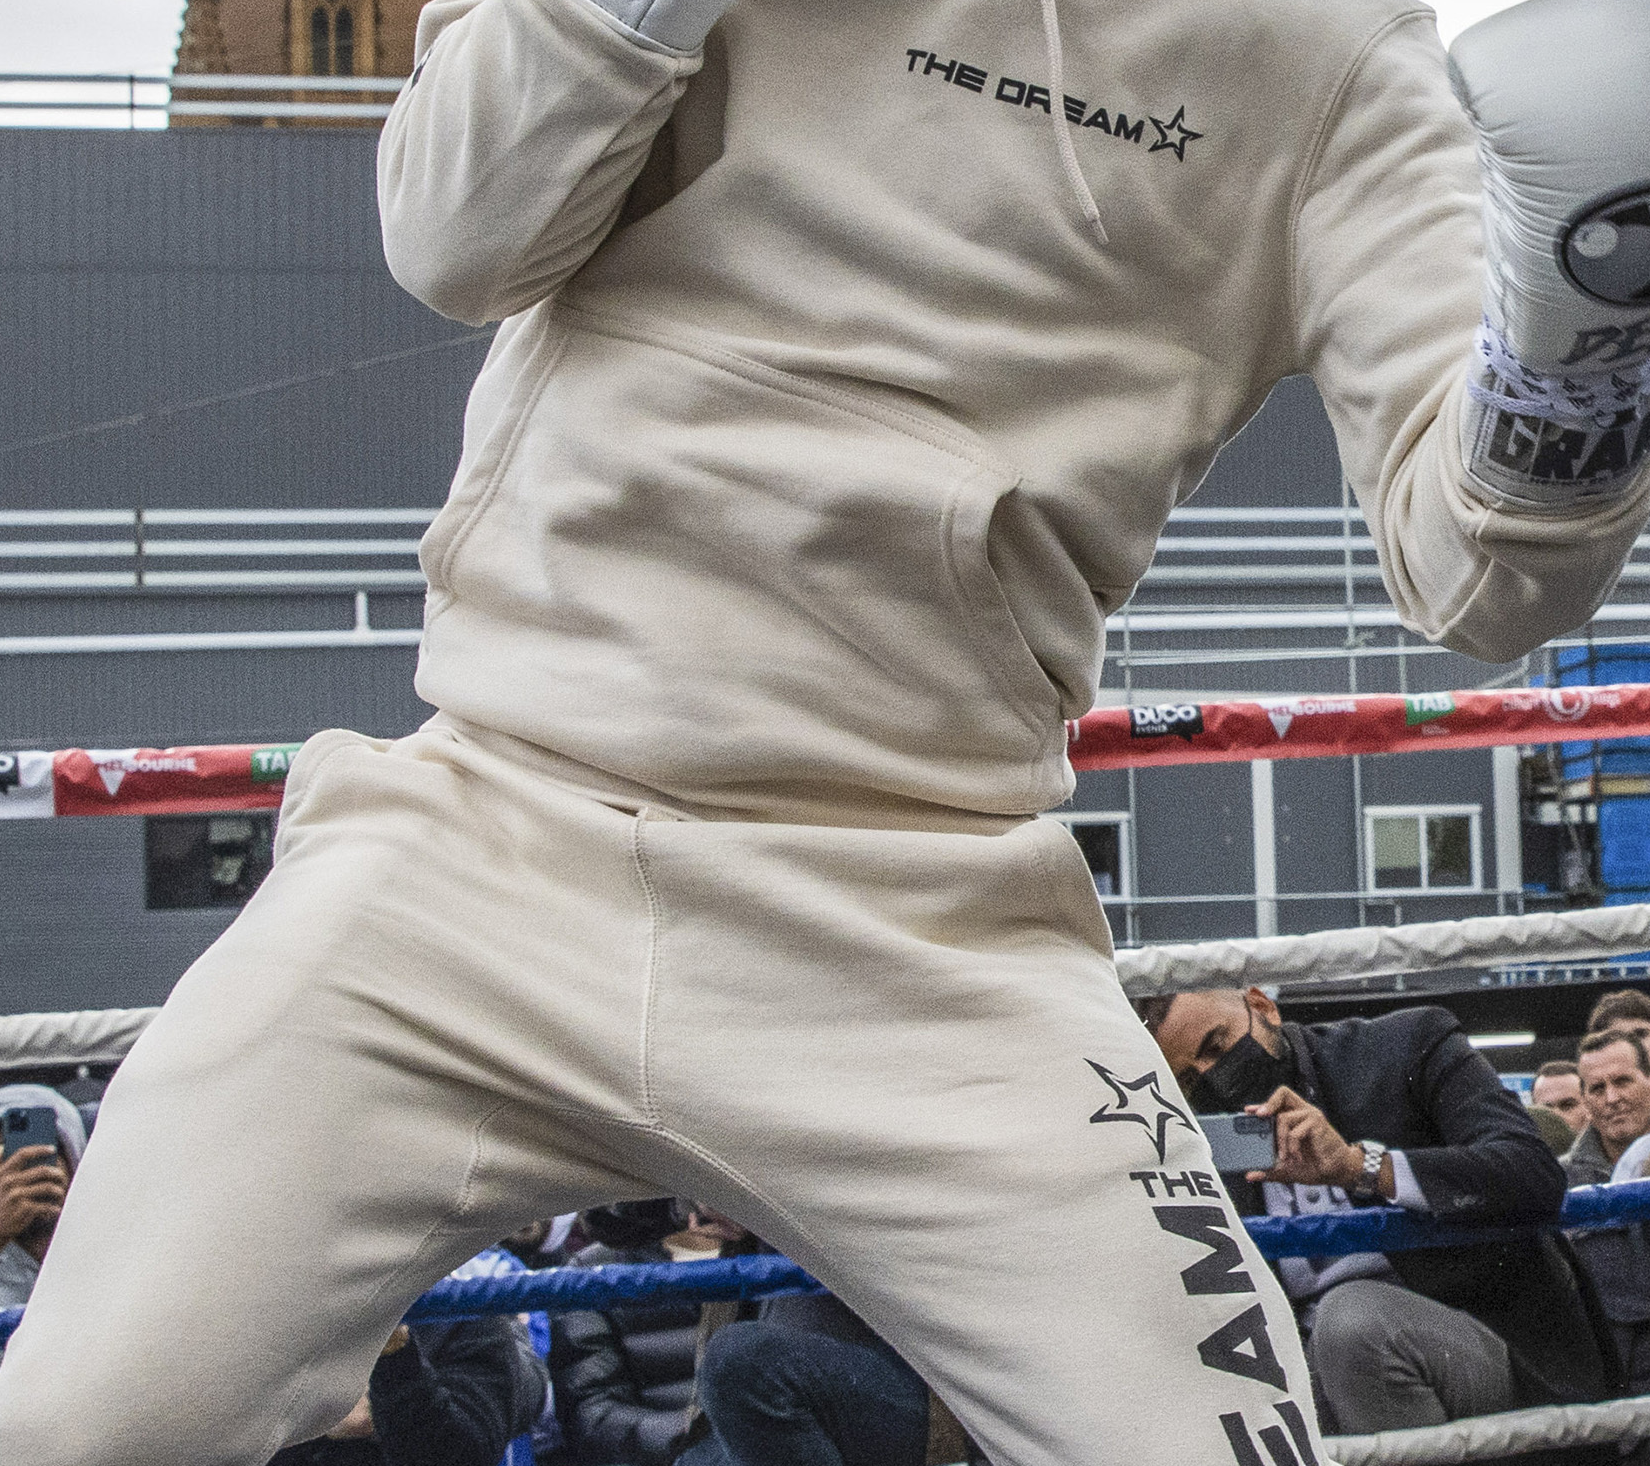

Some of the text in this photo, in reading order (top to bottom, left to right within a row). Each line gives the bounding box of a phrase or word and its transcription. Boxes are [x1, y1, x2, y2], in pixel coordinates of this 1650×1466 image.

[906, 48, 1145, 144] THE DREAM
[1133, 704, 1197, 726] DUCO
[1130, 1170, 1222, 1200] THE
